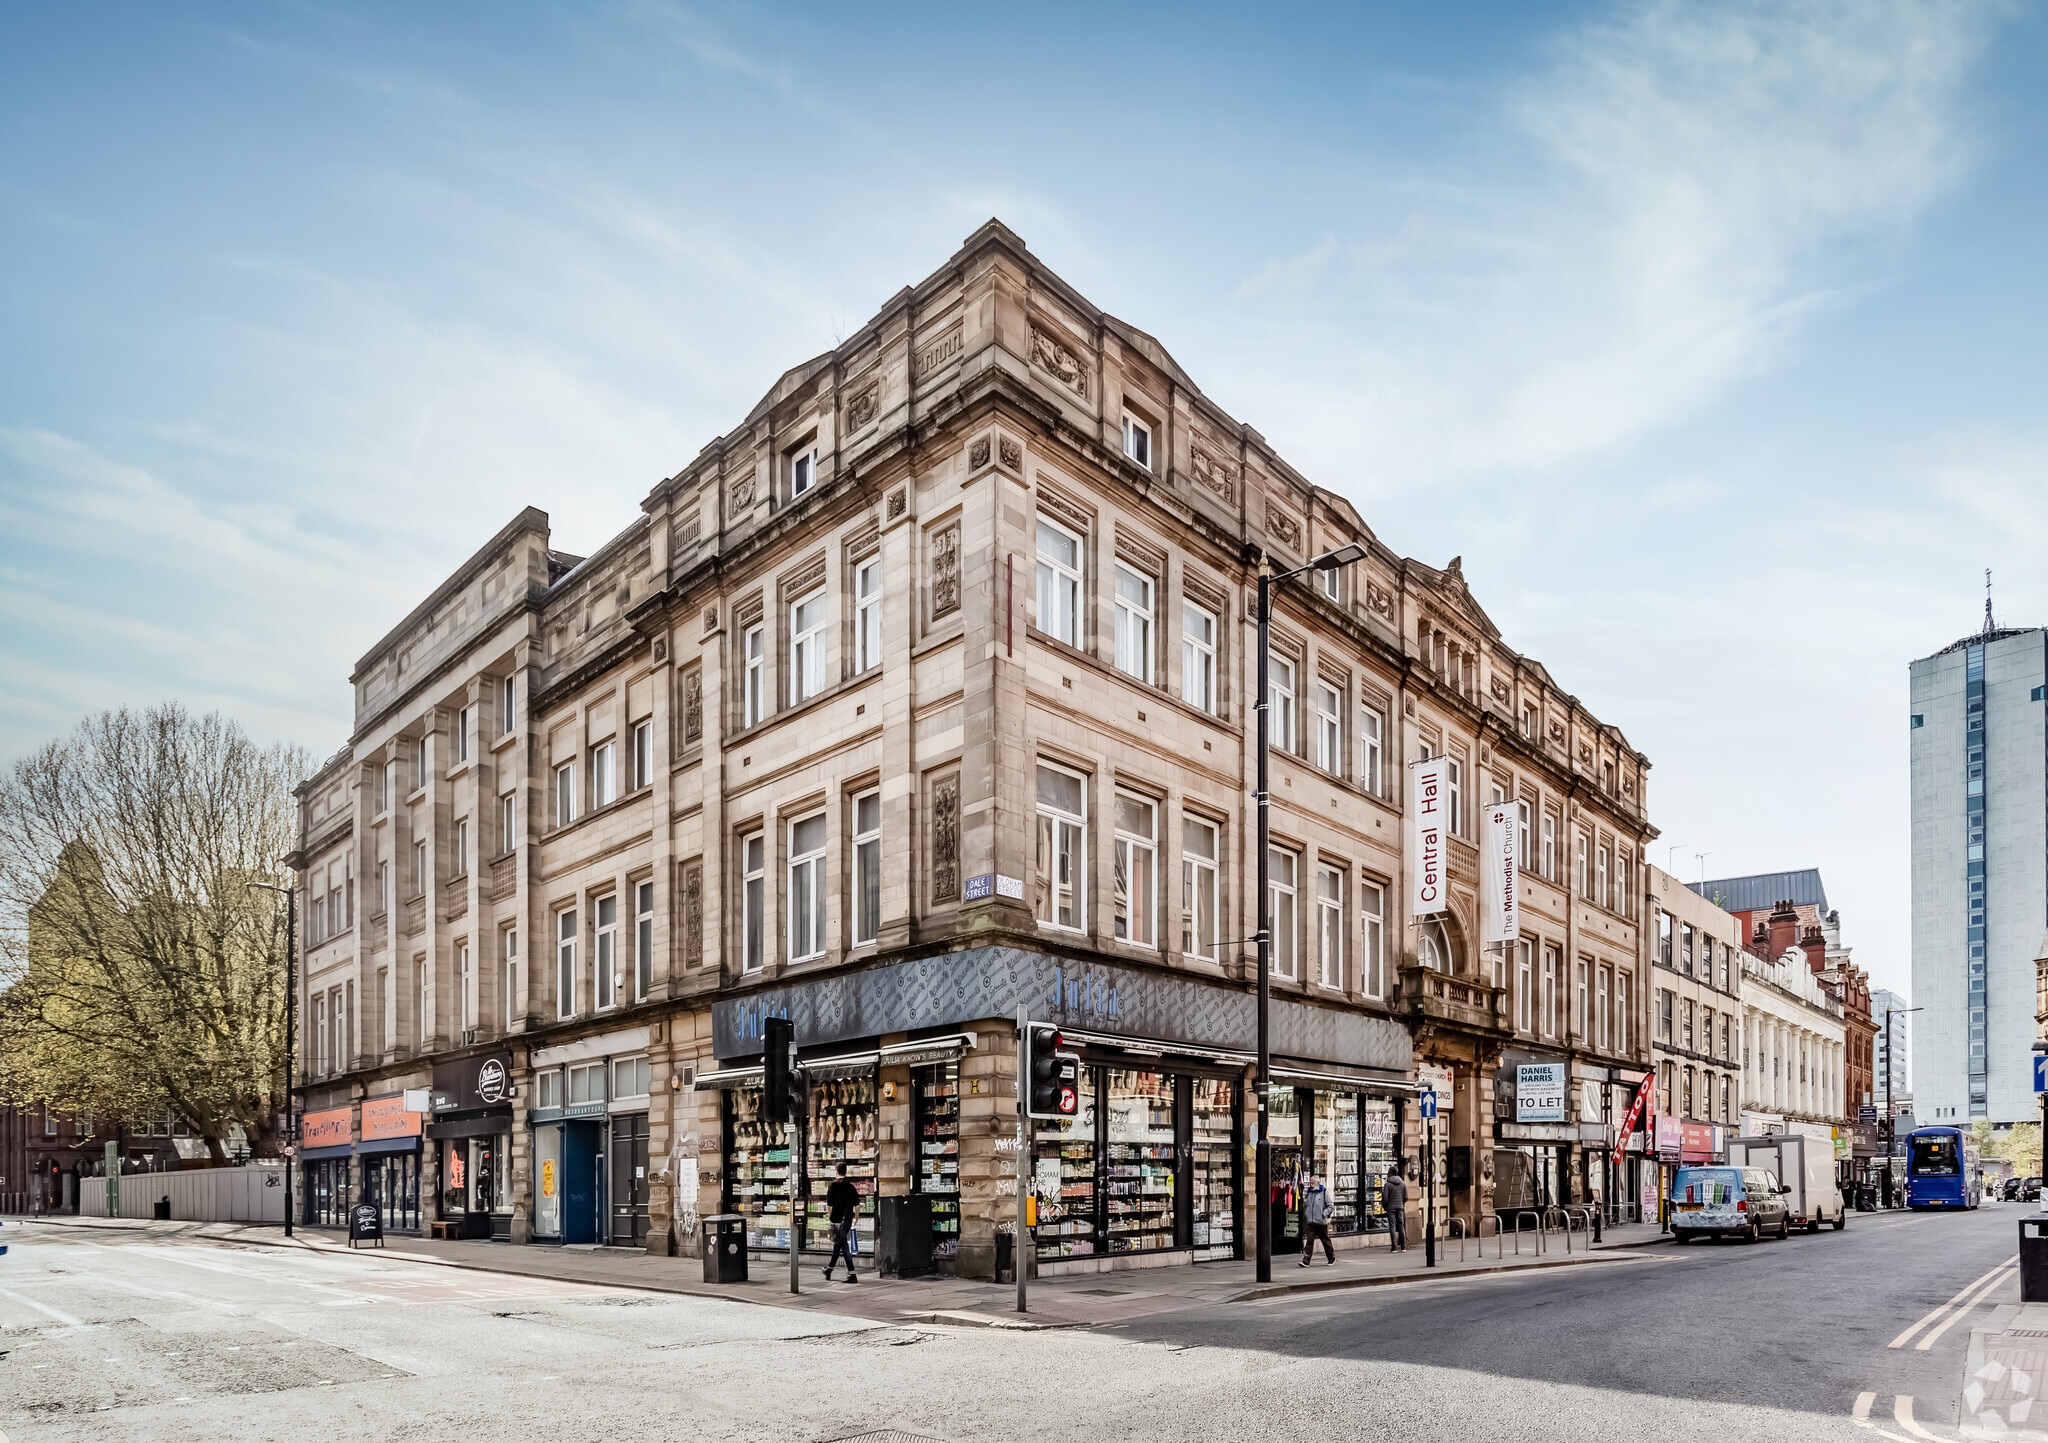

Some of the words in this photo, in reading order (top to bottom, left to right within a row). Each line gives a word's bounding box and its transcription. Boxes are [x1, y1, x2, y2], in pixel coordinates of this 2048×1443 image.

[1421, 773, 1438, 815] Hall
[1503, 816, 1513, 855] Church
[1421, 827, 1438, 902] Central
[970, 877, 986, 889] DALE
[998, 877, 1022, 888] OLDHAM
[1504, 856, 1513, 913] Methodist
[966, 886, 990, 899] STREET
[998, 885, 1022, 898] STREET
[1504, 914, 1513, 935] The
[1051, 966, 1117, 1016] Julia
[1521, 1066, 1552, 1075] DANIEL
[1521, 1075, 1553, 1083] HARRIS
[1518, 1097, 1535, 1108] TO
[1539, 1097, 1562, 1107] LET
[1613, 1079, 1649, 1160] TATTOO
